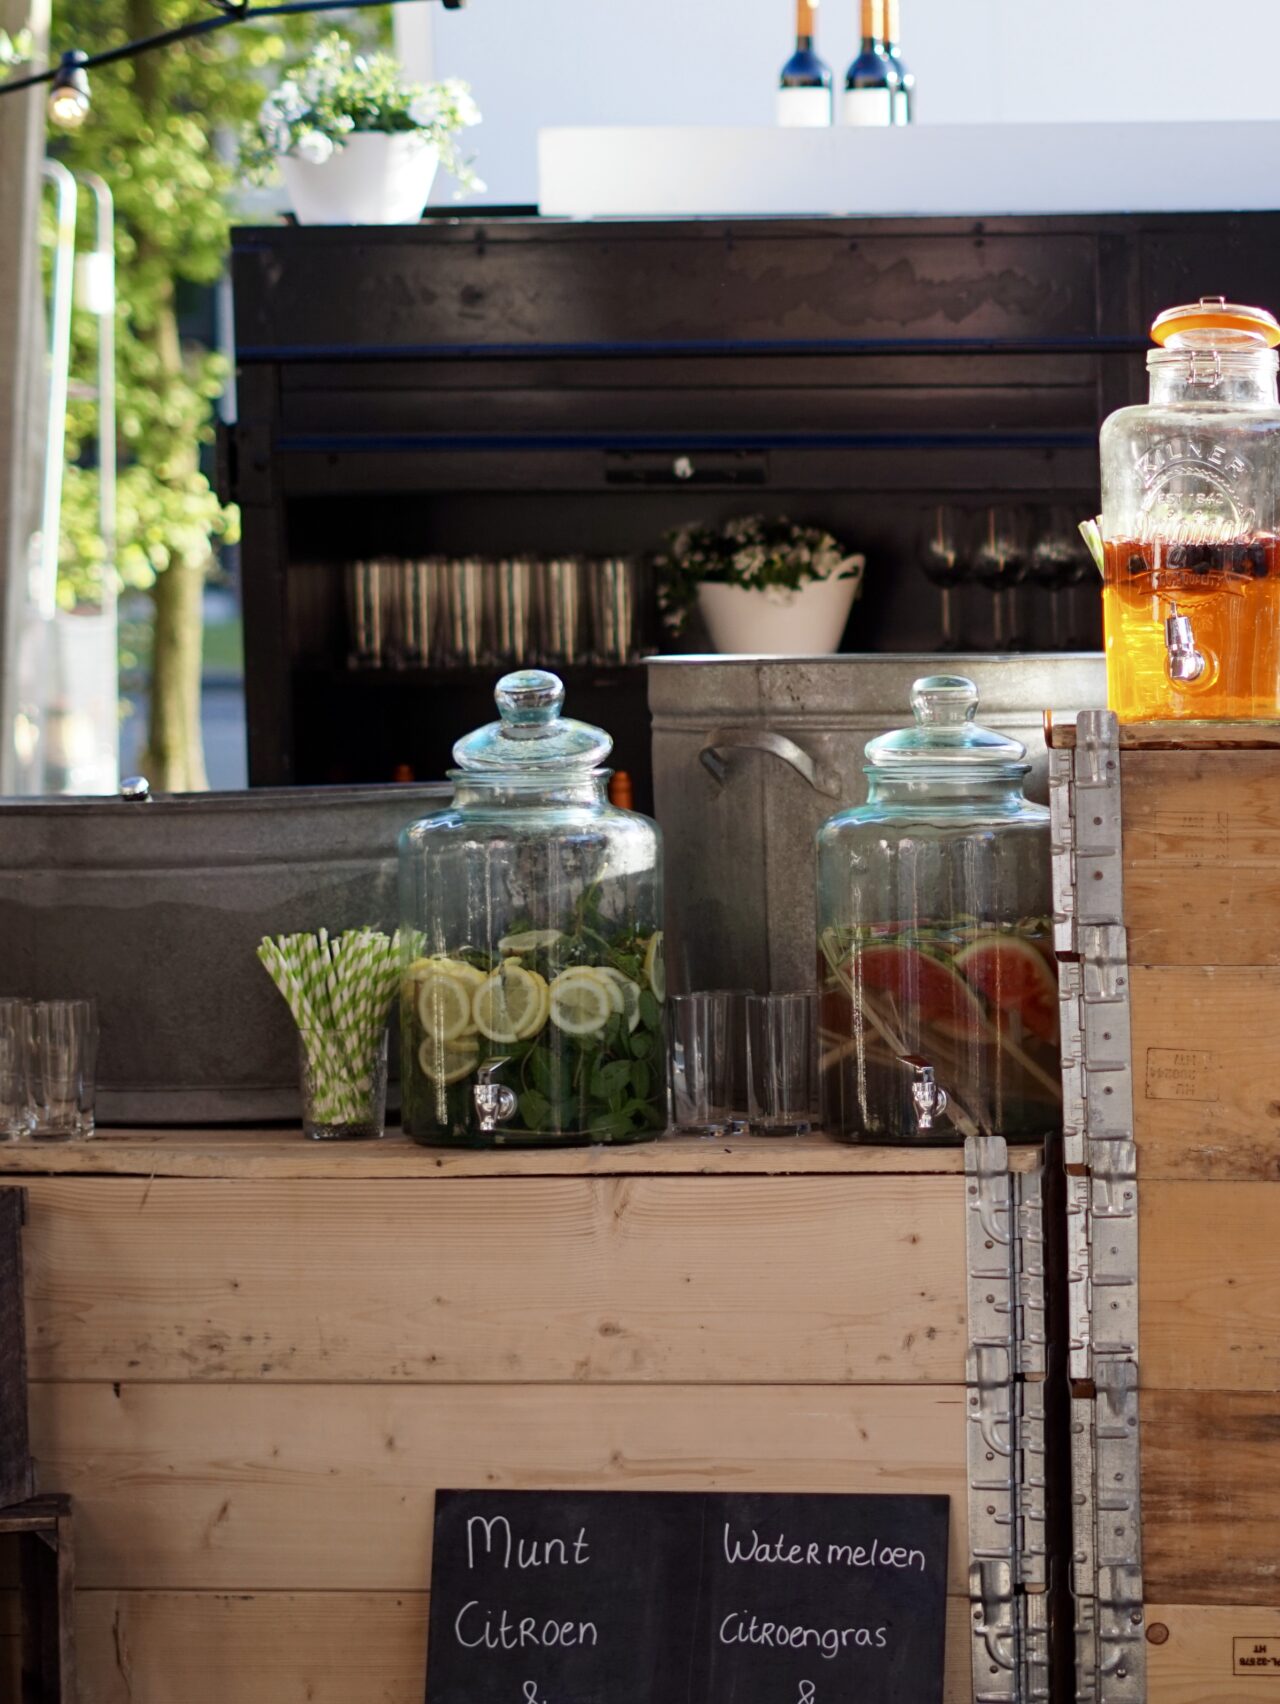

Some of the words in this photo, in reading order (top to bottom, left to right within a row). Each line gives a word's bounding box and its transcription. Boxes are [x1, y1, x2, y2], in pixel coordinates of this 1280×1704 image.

[1157, 492, 1184, 505] EST
[467, 1515, 591, 1570] Munt
[1252, 1644, 1267, 1654] HT
[798, 1679, 815, 1704] &
